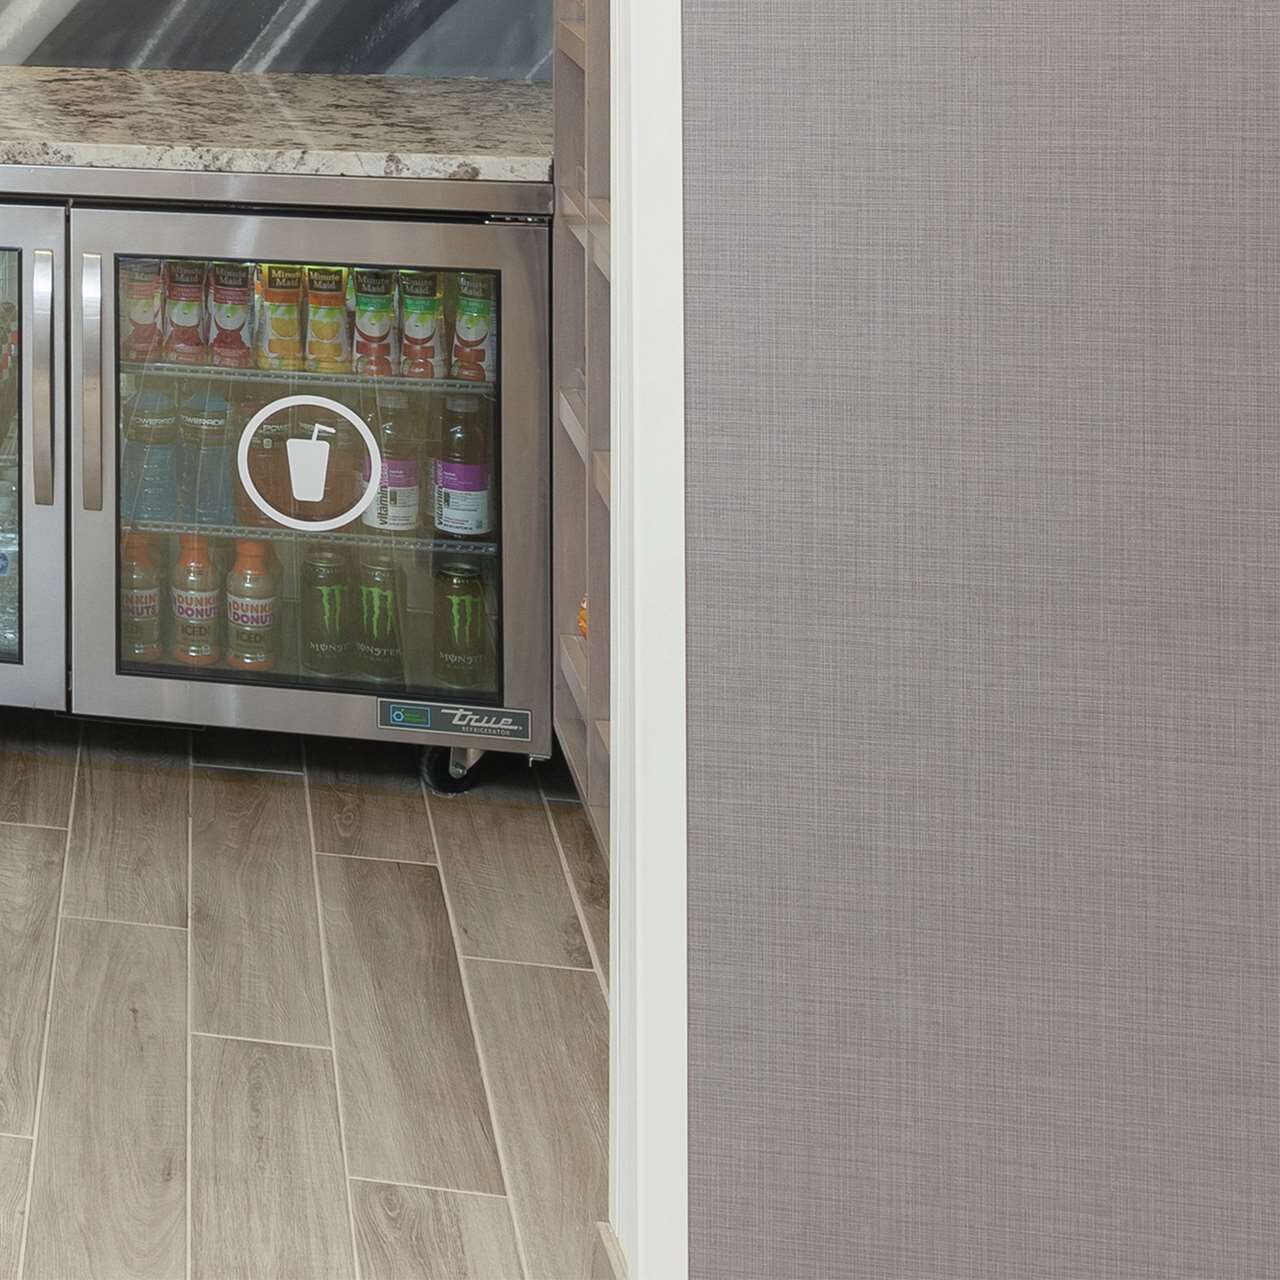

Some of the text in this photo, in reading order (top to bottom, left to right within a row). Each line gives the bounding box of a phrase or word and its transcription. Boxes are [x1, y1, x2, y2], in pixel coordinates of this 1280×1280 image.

[275, 277, 298, 287] Maid
[313, 280, 336, 289] Maid
[125, 594, 157, 606] NKIN
[176, 594, 217, 607] DUNKI
[127, 605, 158, 617] NUTS
[176, 605, 217, 618] DONUT
[232, 601, 273, 614] DUNKI
[232, 613, 272, 625] DONUT
[441, 708, 518, 730] true
[461, 726, 511, 736] REFRIGERATOR
